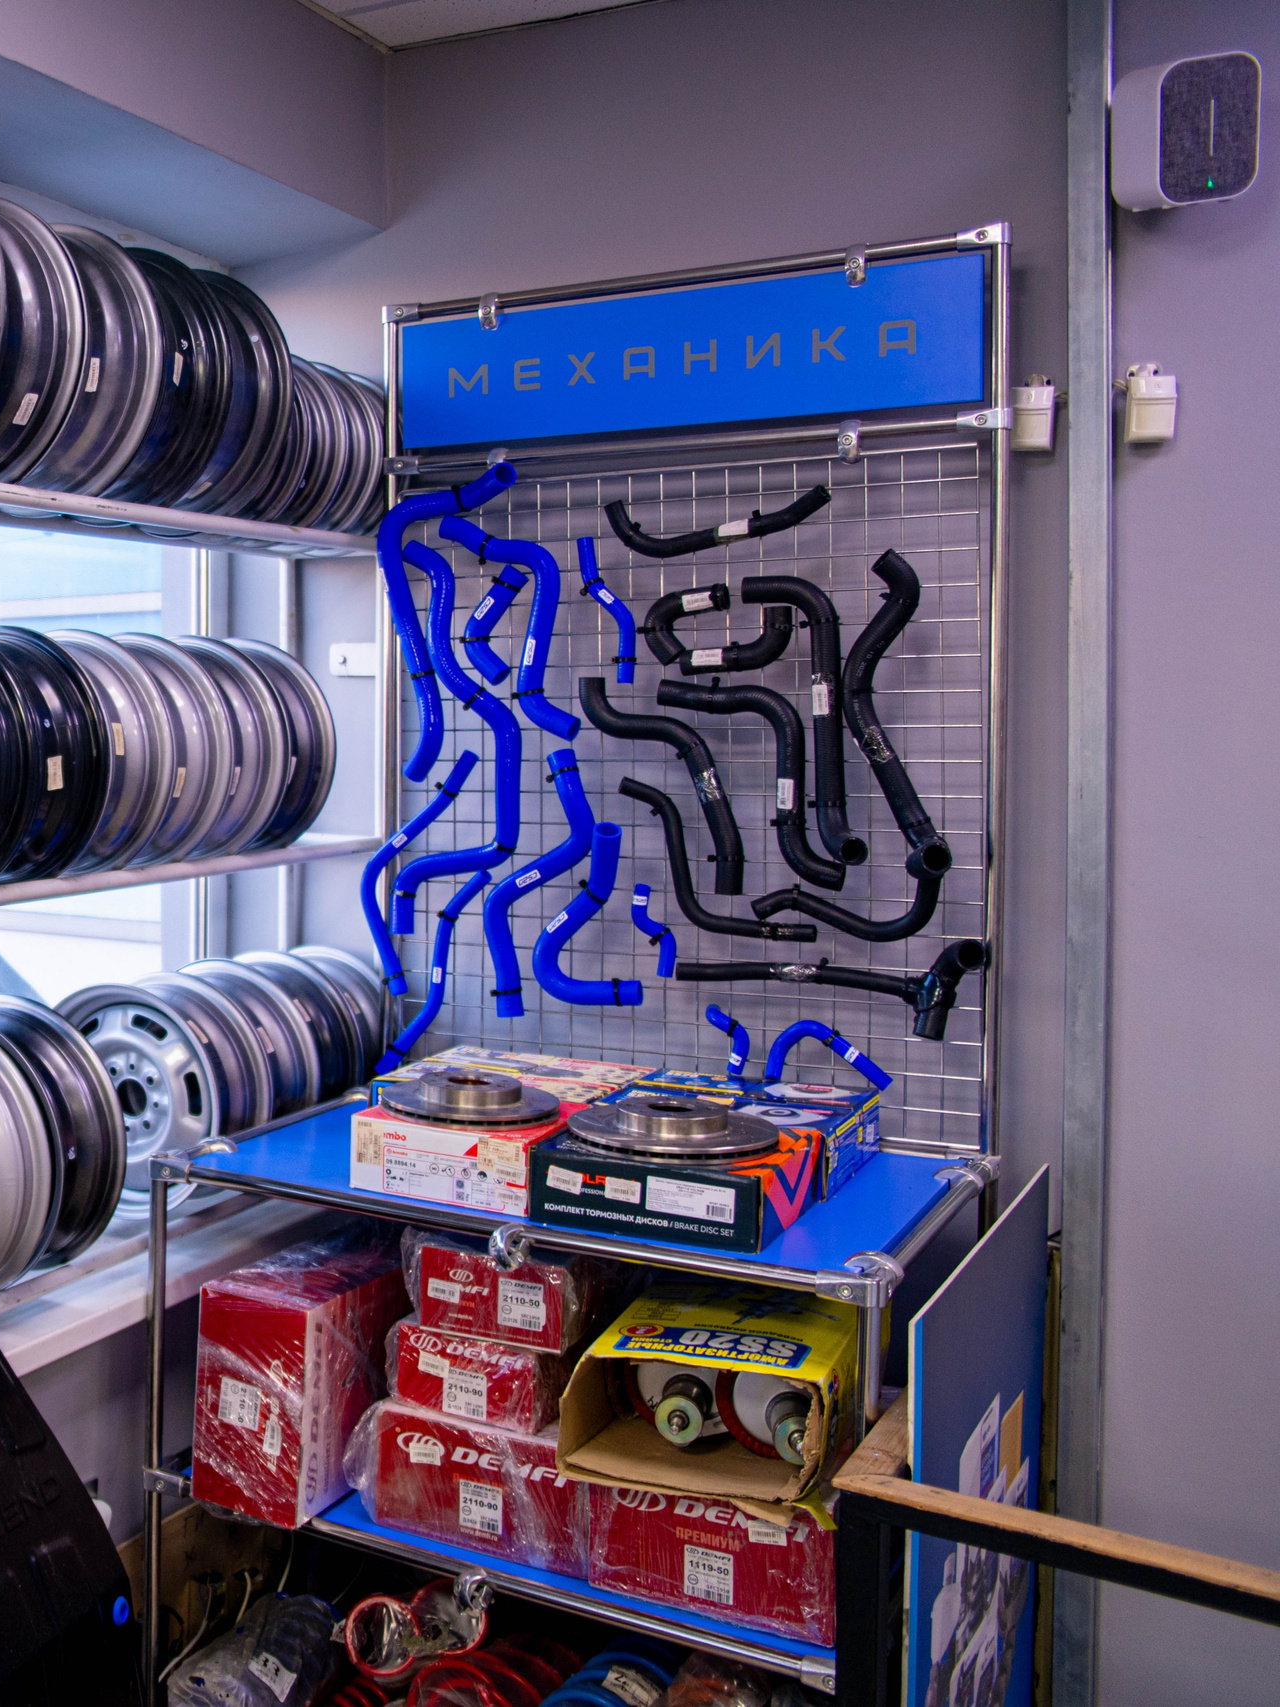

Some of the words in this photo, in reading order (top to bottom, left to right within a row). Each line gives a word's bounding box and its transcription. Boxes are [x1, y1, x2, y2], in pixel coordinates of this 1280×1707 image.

[448, 319, 917, 398] МЕХАНИКА
[518, 871, 539, 887] CS20
[544, 1202, 585, 1215] КОМПЛЕКТ
[585, 1208, 635, 1223] ТОРМОЗНЫХ
[634, 1215, 669, 1228] ДИСКОВ
[674, 1221, 699, 1232] BRAKE
[700, 1225, 719, 1235] DISC
[720, 1227, 735, 1238] SET
[502, 1294, 541, 1308] 2110-50
[446, 1342, 526, 1369] DEMFI
[625, 1341, 790, 1366] АМОРТИЗАТОРНЫЕ
[678, 1329, 798, 1358] SS20
[447, 1382, 484, 1398] 2110-90
[450, 1446, 568, 1488] DEMFI
[462, 1496, 499, 1511] 2110-90
[675, 1526, 740, 1553] ПРЕМИУМ
[688, 1559, 730, 1576] 1119-50
